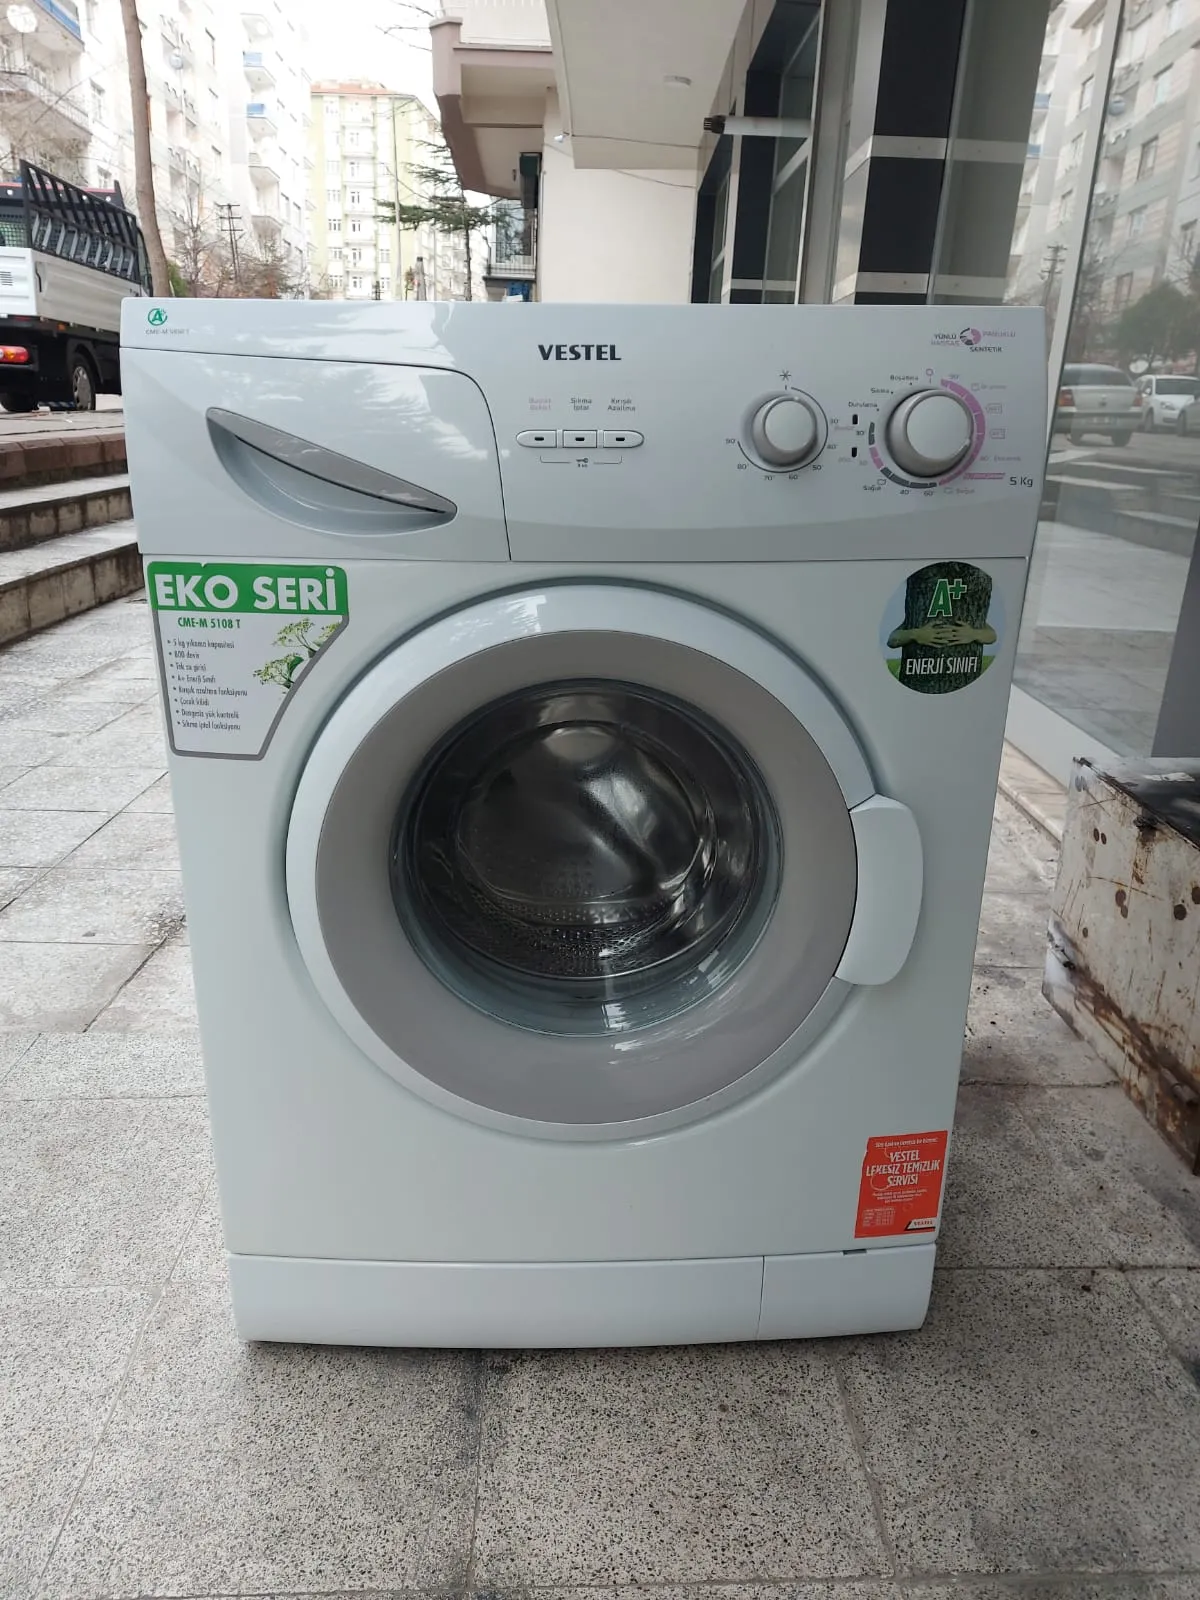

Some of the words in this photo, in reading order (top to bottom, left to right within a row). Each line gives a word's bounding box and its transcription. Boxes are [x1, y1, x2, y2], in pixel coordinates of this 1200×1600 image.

[538, 344, 622, 361] VESTEL
[1009, 476, 1017, 486] 5
[1020, 476, 1034, 487] Kg
[154, 573, 239, 609] EKO
[252, 567, 337, 611] SERİ
[927, 578, 968, 618] A+
[177, 616, 208, 628] CME-M
[210, 618, 234, 629] 5108
[235, 618, 241, 629] T
[178, 637, 186, 649] kg
[905, 654, 944, 675] ENERJİ
[946, 656, 978, 674] SINIFI
[889, 1149, 921, 1163] VESTEL
[865, 1163, 901, 1177] LEKESİZ
[902, 1159, 941, 1174] TEMİZLİK
[887, 1173, 919, 1188] SERVİSİ
